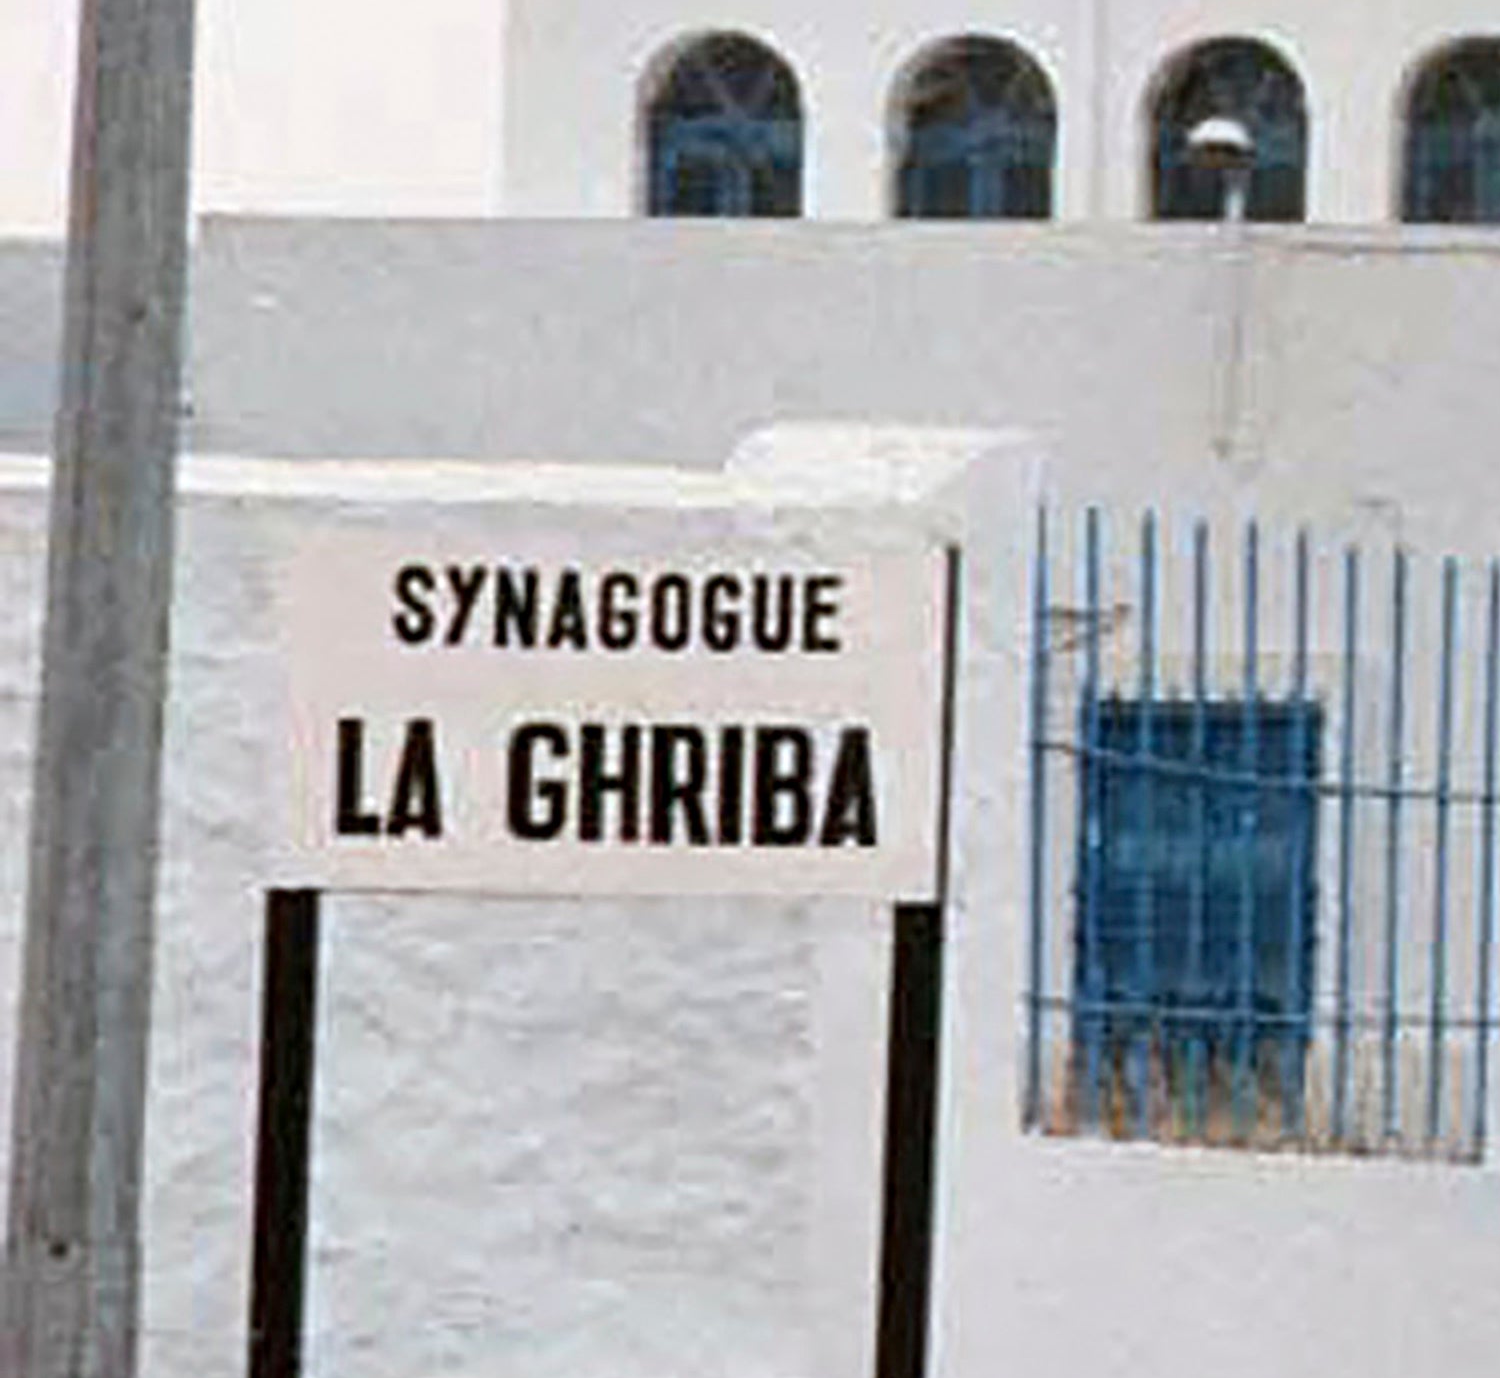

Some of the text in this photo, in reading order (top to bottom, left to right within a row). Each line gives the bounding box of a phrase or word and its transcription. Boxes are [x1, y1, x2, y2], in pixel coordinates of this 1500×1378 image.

[391, 564, 844, 654] SYNAGOGUE
[333, 716, 879, 849] LA GHRIBA
